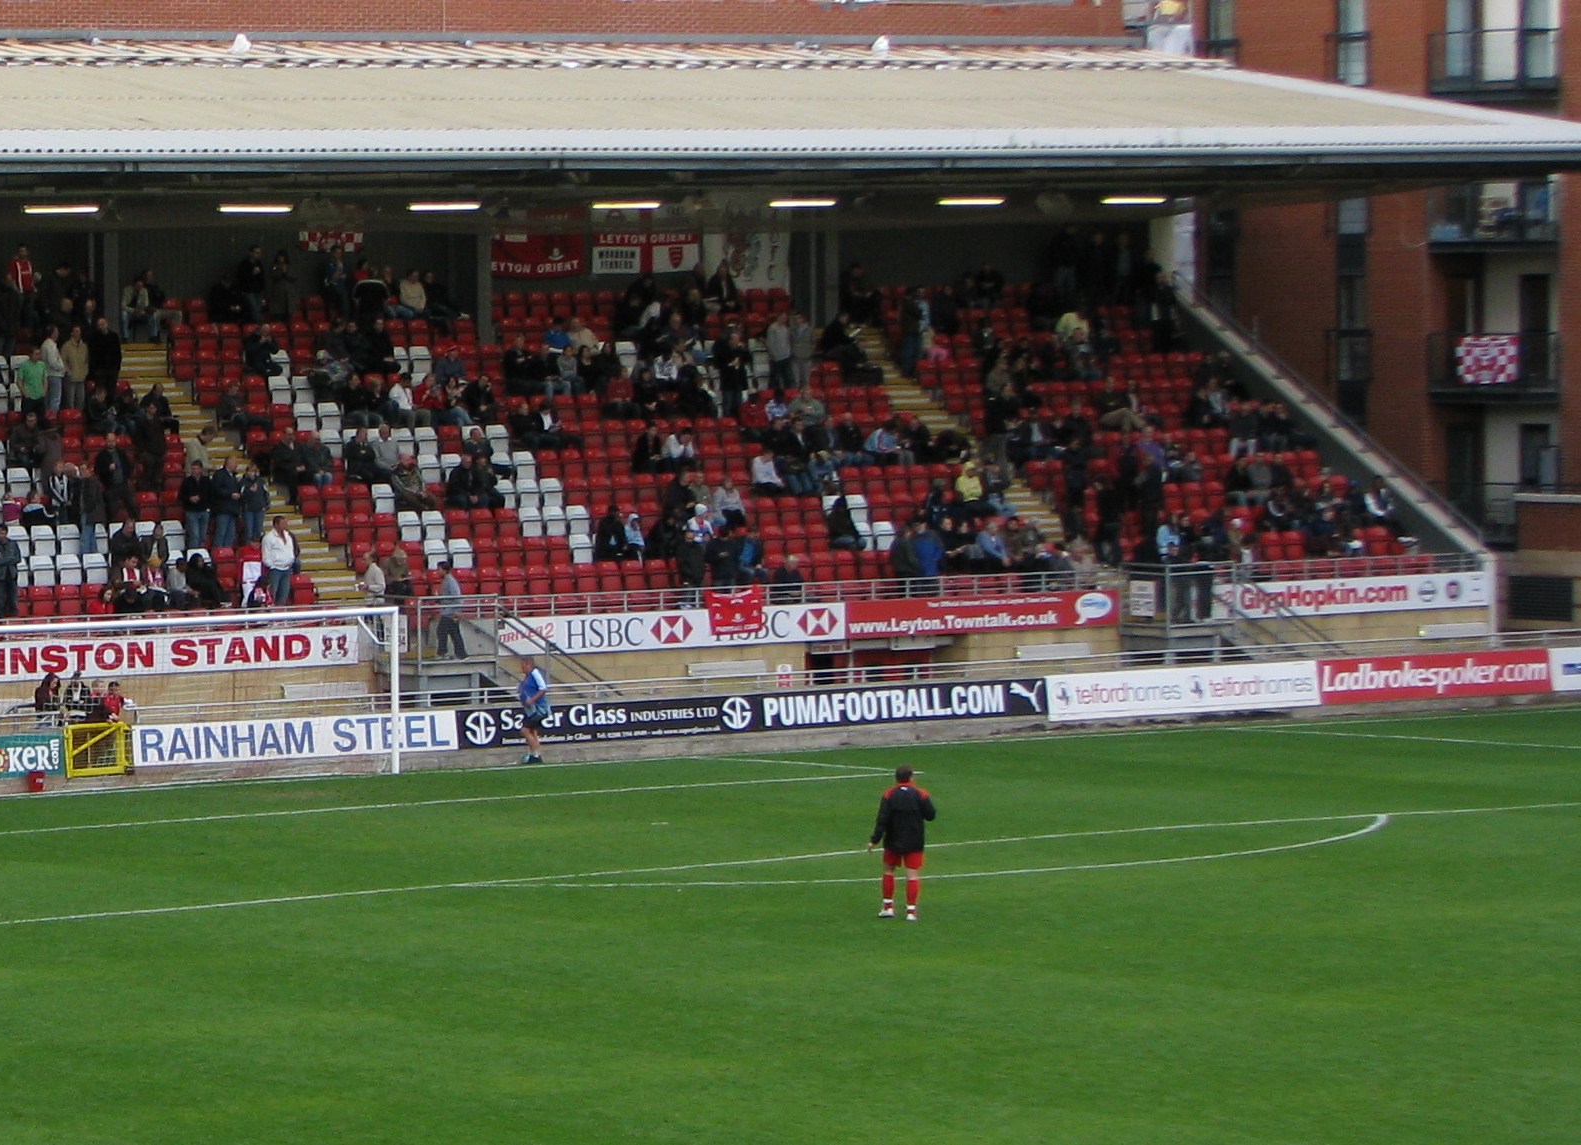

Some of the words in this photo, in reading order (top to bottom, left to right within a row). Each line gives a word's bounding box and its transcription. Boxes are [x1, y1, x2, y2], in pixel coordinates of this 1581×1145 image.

[599, 234, 646, 244] LEYTON
[492, 261, 531, 273] EYTON
[537, 260, 579, 273] ORIENT
[566, 617, 644, 649] HSBC
[849, 610, 1058, 634] www.Leyton.Towntalk.co.uk
[170, 633, 312, 668] STAND
[1208, 676, 1312, 698] telfordhomes
[1322, 657, 1547, 693] Ladbrokespoker.com
[764, 683, 1005, 727] PUMAFOOTBALL.COM
[1075, 682, 1181, 705] telfordhomes
[500, 708, 563, 732] Saer
[569, 703, 627, 727] Glass
[630, 711, 694, 722] INDUSTRIES
[696, 708, 717, 718] LTD
[140, 721, 313, 762] RAINHAM
[332, 714, 450, 752] STEEL
